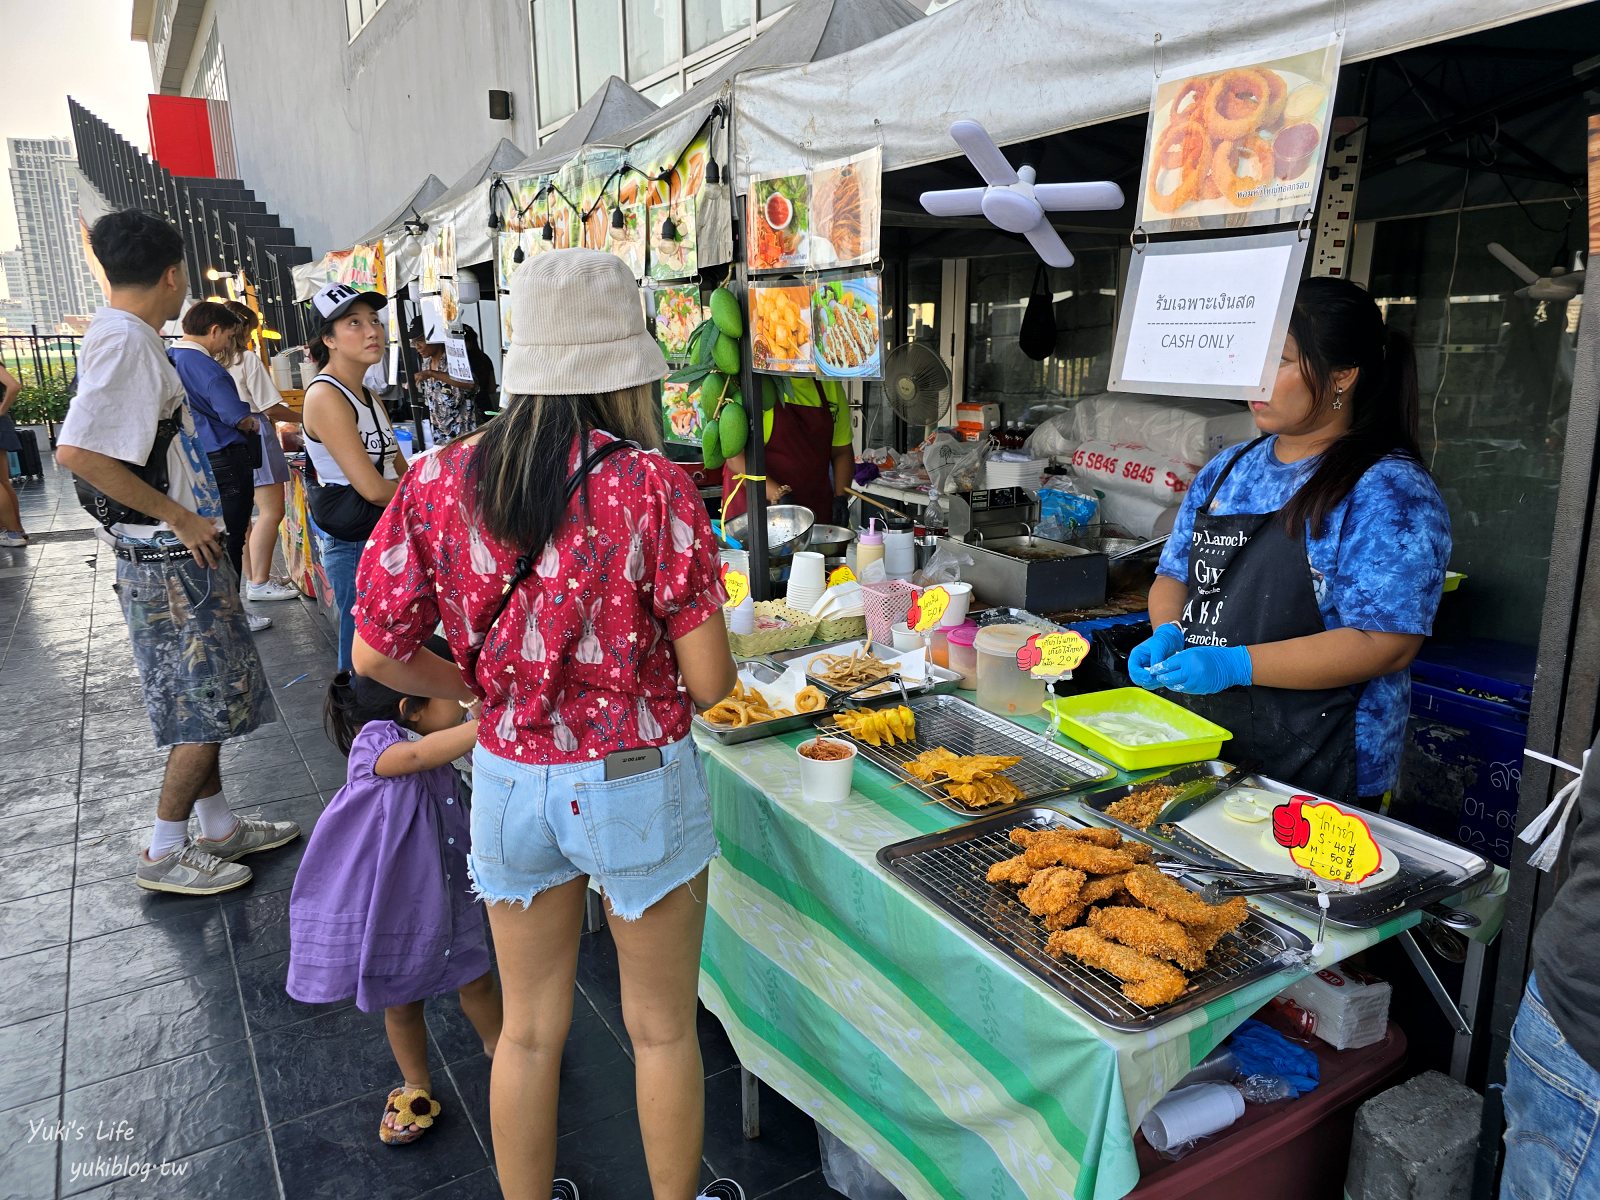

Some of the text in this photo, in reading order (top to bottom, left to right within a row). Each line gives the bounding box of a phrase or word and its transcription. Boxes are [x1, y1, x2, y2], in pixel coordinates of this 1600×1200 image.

[1156, 293, 1256, 311] รับเฉพาะเงินสด
[1161, 334, 1235, 348] CASH ONLY
[1086, 452, 1118, 474] SB45
[1122, 461, 1156, 484] SB45
[1203, 530, 1252, 547] Laroch
[1199, 547, 1226, 556] PARIS
